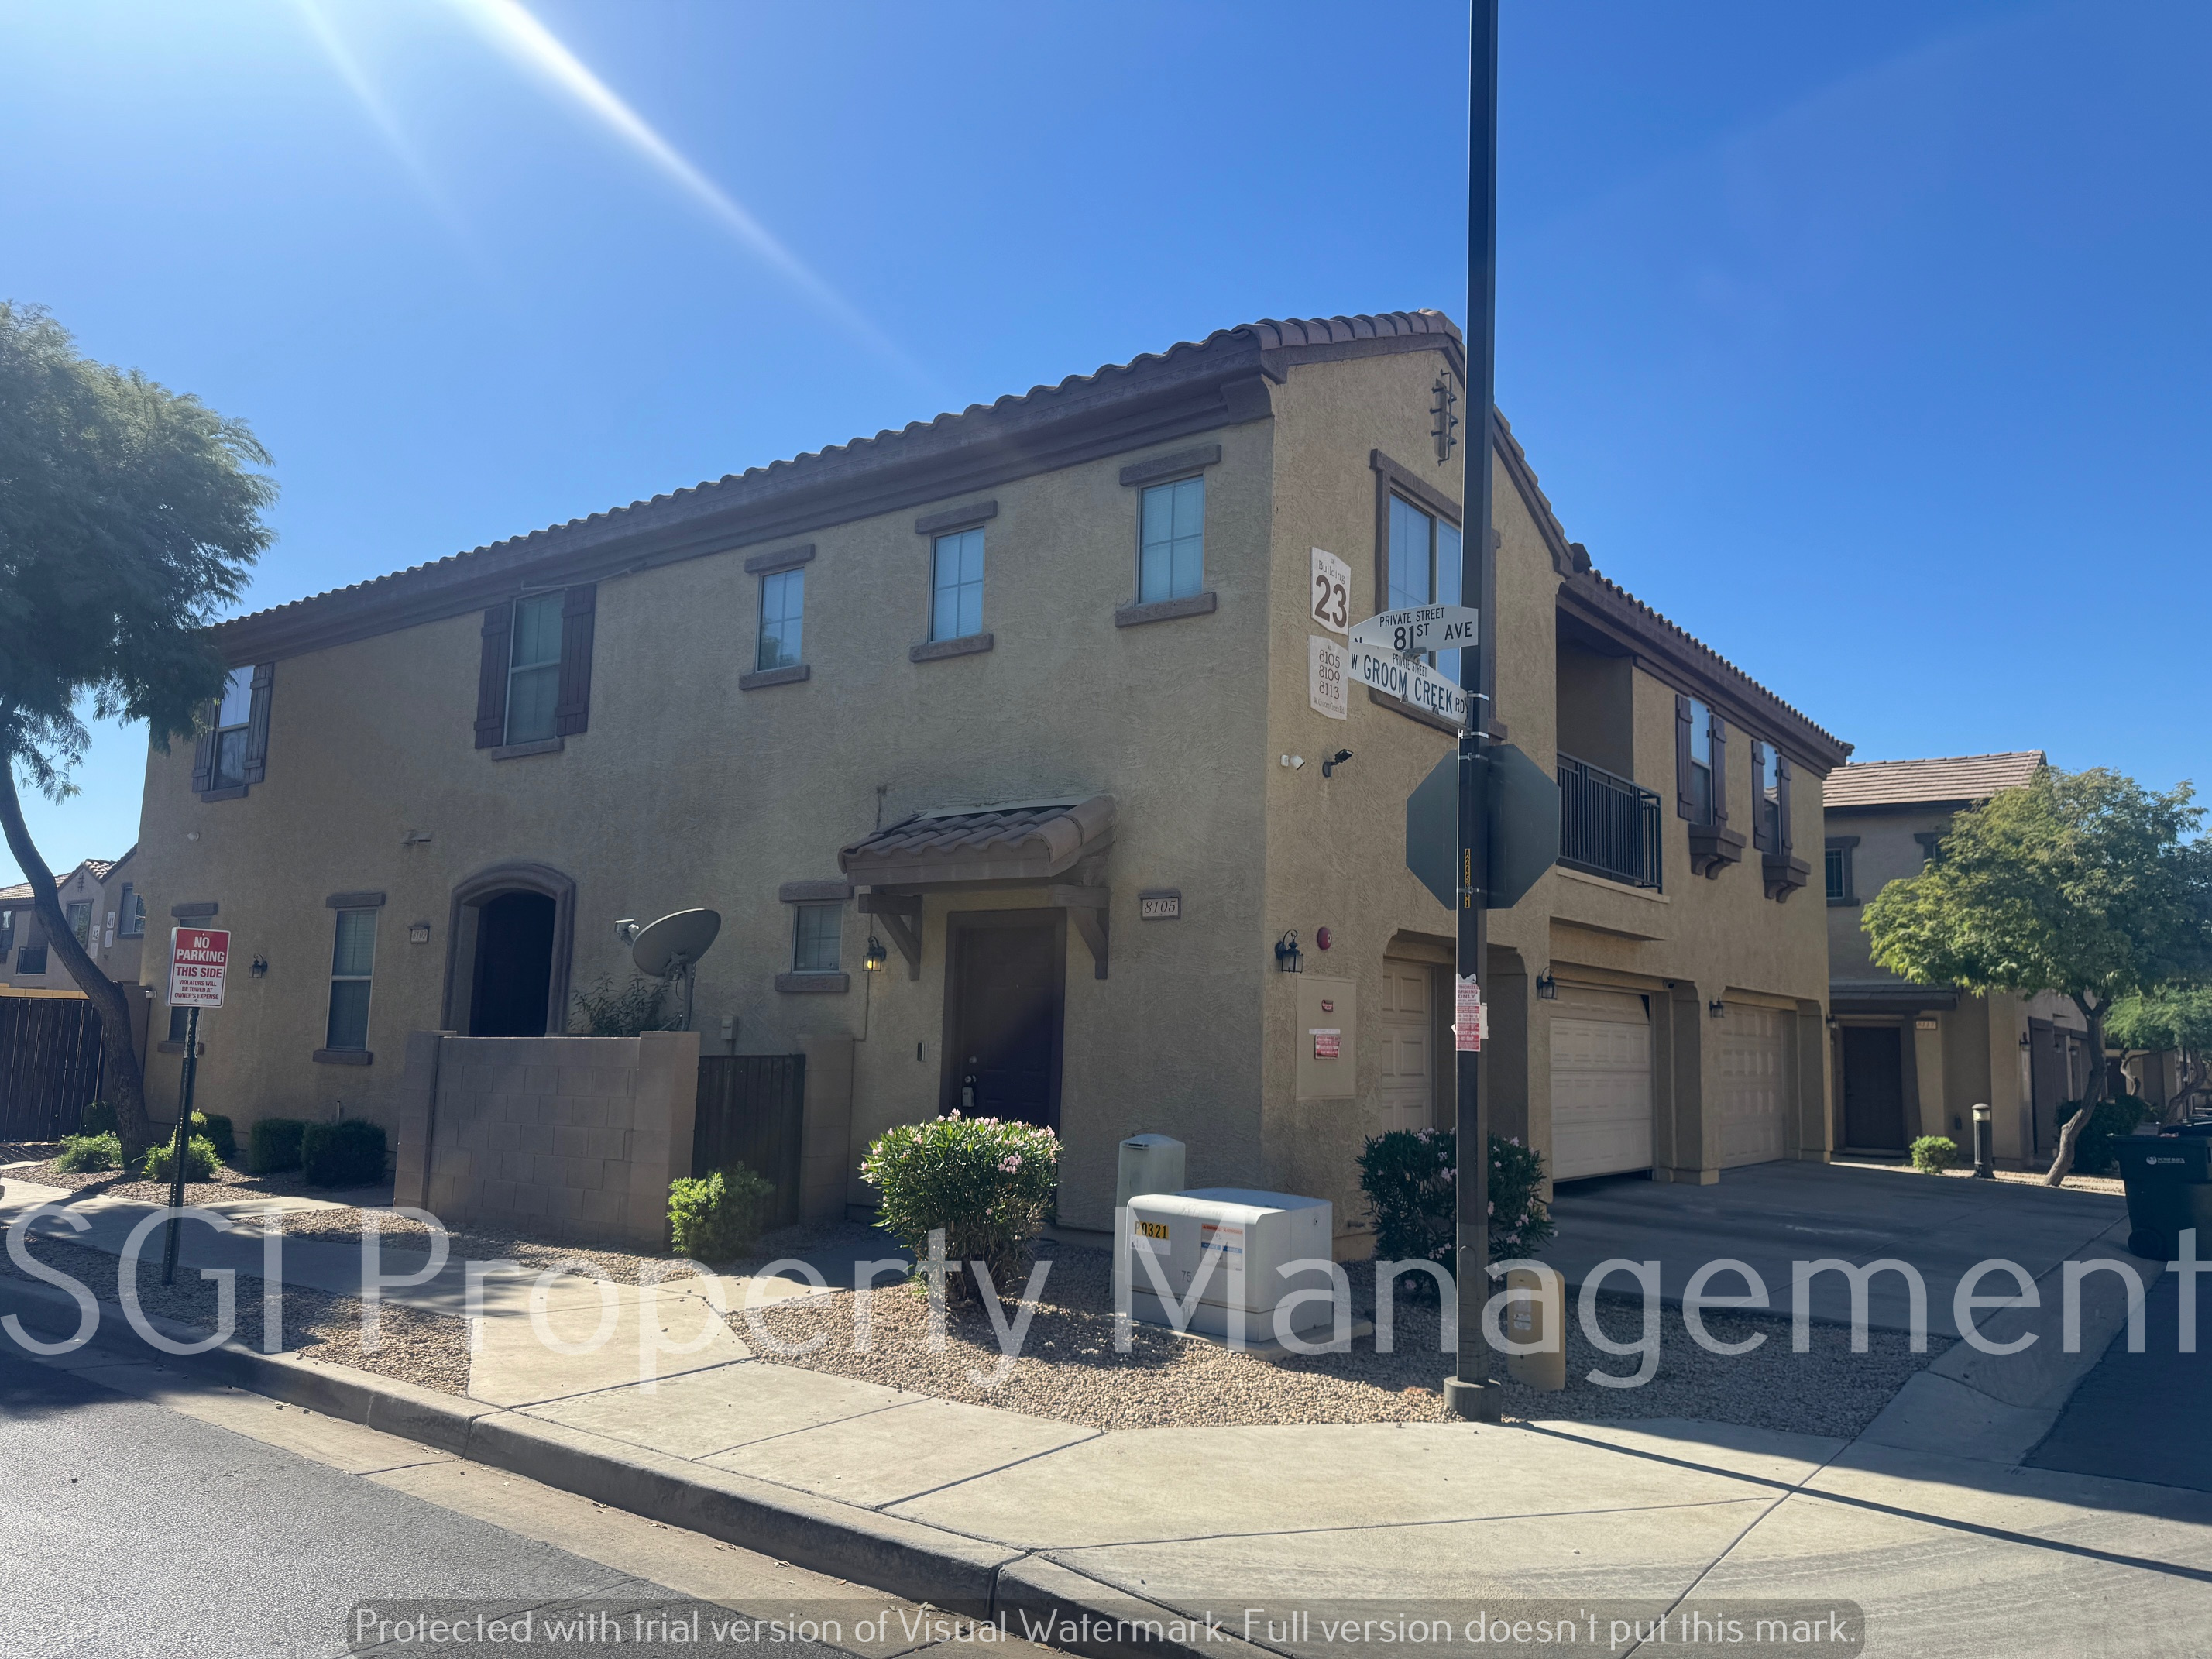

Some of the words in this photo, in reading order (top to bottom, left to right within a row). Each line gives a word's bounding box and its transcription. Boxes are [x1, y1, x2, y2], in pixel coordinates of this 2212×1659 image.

[1318, 559, 1345, 585] Building
[1314, 574, 1347, 628] 23
[1379, 612, 1411, 627] PRIVATE
[1416, 607, 1444, 622] STREET
[1444, 622, 1472, 640] AVE
[1319, 649, 1340, 668] 8105
[1393, 653, 1410, 670] PRIVATE
[1412, 663, 1427, 677] STREET
[1319, 665, 1340, 683] 8109
[1319, 681, 1340, 699] 8113
[1351, 653, 1358, 670] W
[1364, 654, 1407, 695] GROOM
[1414, 677, 1452, 714] CREEK
[1455, 697, 1465, 714] RD
[1144, 900, 1176, 913] 8105
[194, 936, 210, 949] NO
[176, 949, 225, 963] PARKING
[176, 966, 198, 977] THIS
[200, 967, 222, 978] SIDE
[1135, 1221, 1167, 1238] P0321
[1182, 1270, 1191, 1282] 75
